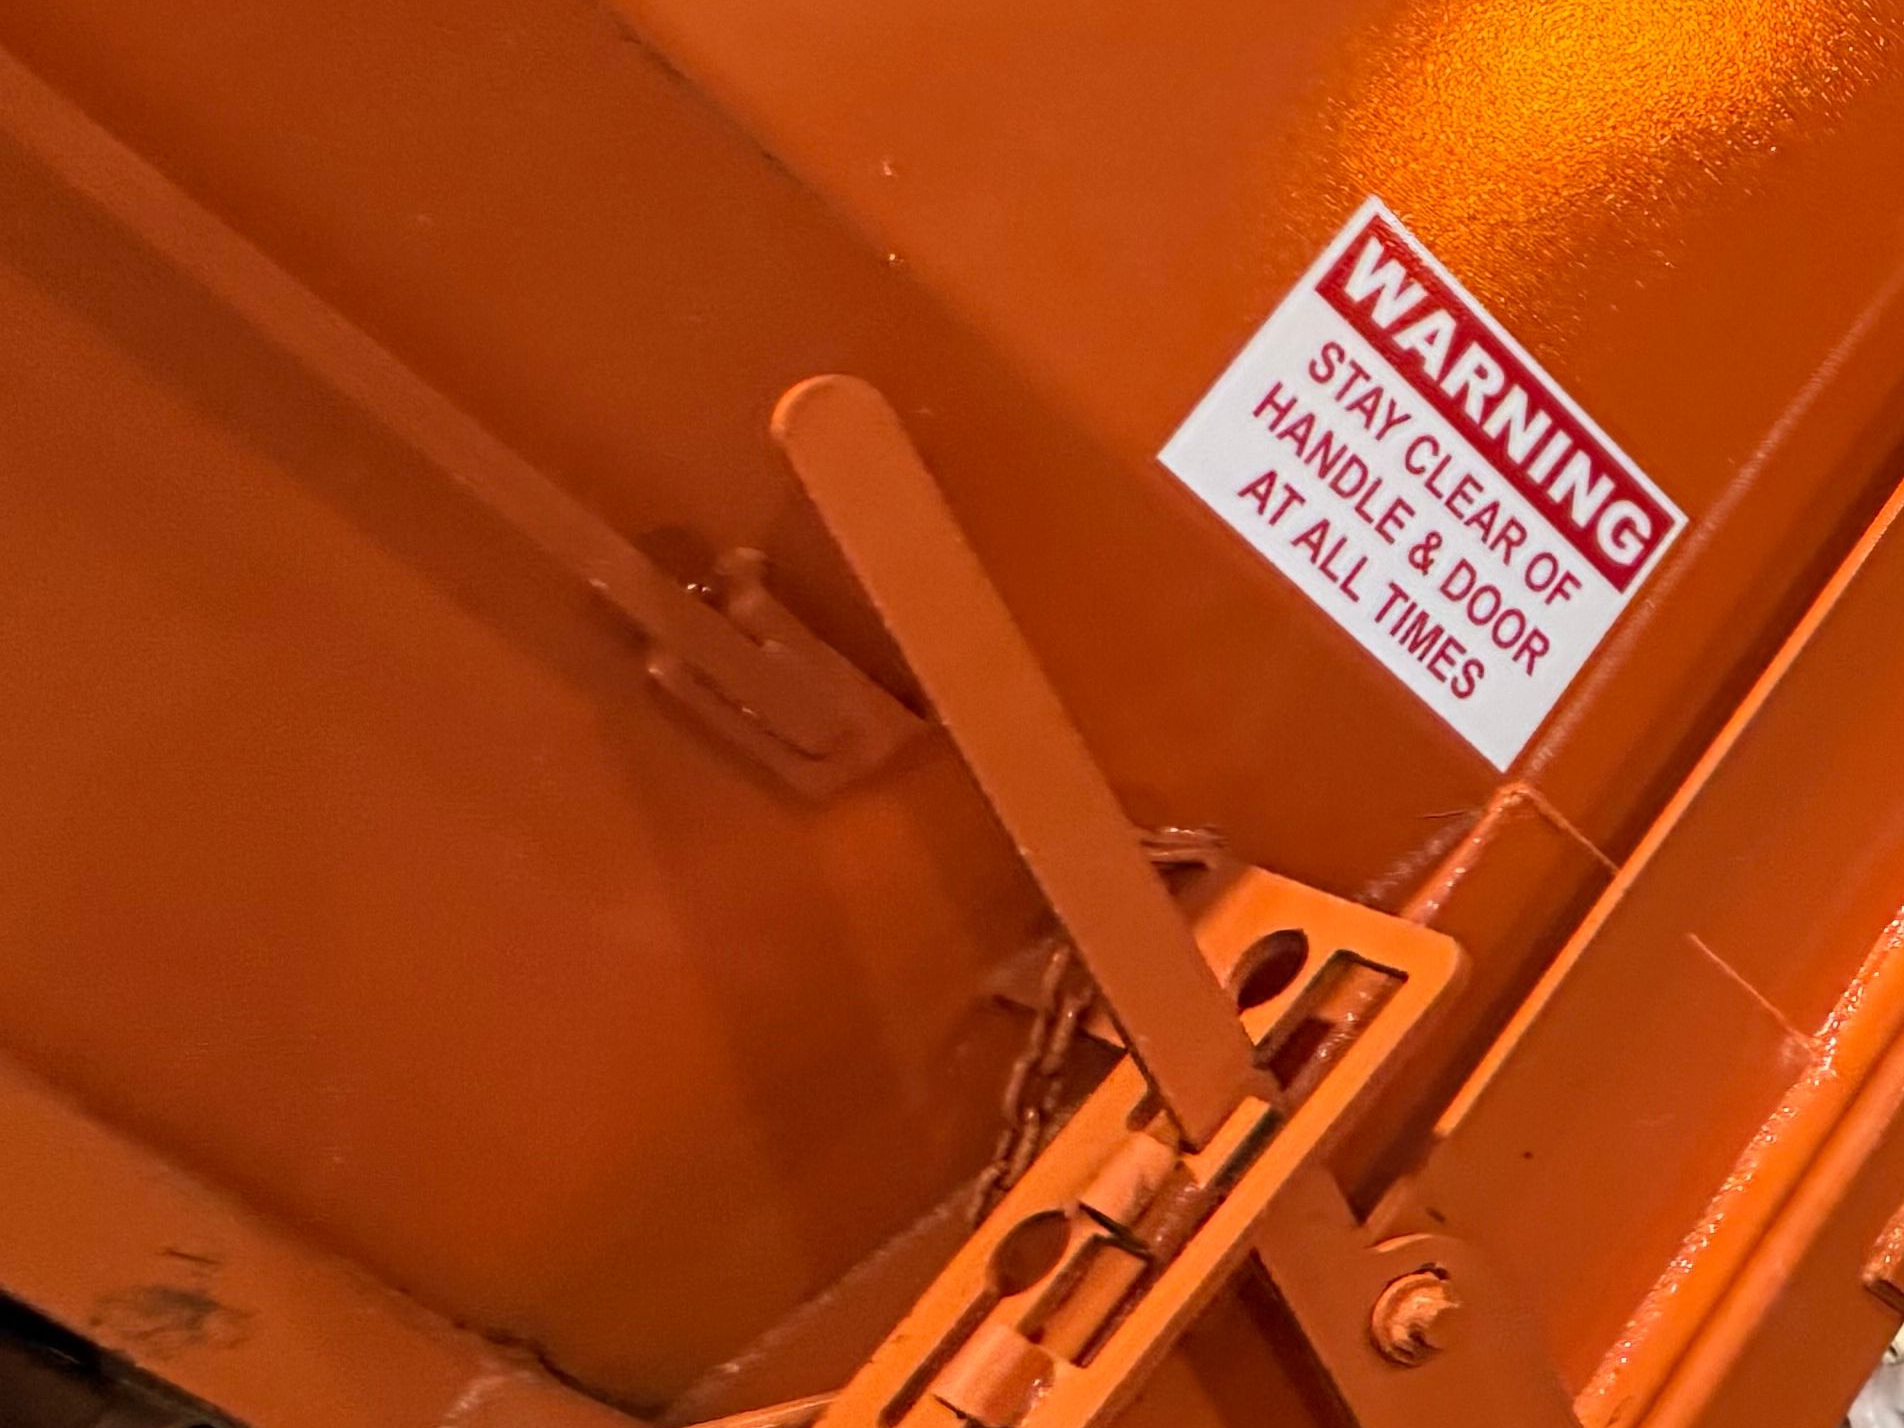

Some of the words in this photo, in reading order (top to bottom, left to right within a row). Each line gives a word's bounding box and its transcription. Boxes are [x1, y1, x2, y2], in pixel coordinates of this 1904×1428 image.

[1251, 380, 1416, 545] HANDLE
[1406, 530, 1442, 575] &
[1438, 559, 1551, 676] DOOR
[1306, 339, 1411, 441] STAY
[1402, 432, 1529, 566] CLEAR
[1523, 550, 1582, 604] OF
[1343, 236, 1653, 567] WARNING
[1236, 468, 1306, 527] AT
[1291, 517, 1369, 604] ALL
[1373, 581, 1486, 701] TIMES
